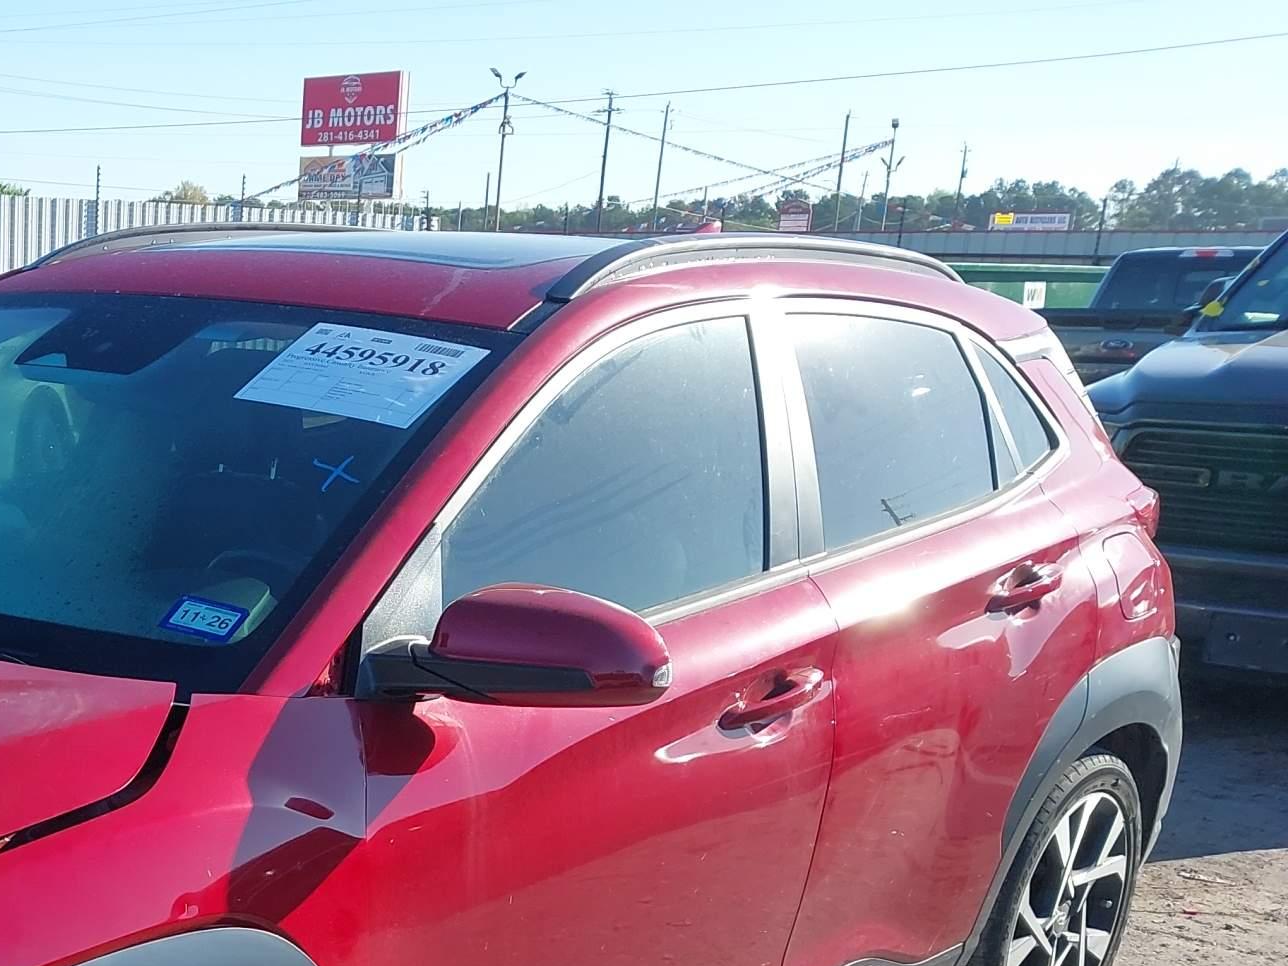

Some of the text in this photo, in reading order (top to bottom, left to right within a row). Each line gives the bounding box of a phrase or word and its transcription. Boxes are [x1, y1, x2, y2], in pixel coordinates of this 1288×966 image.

[305, 104, 395, 128] JB MOTORS
[317, 130, 380, 142] 281-416-4341
[305, 341, 447, 376] 44595918
[205, 614, 233, 630] 26
